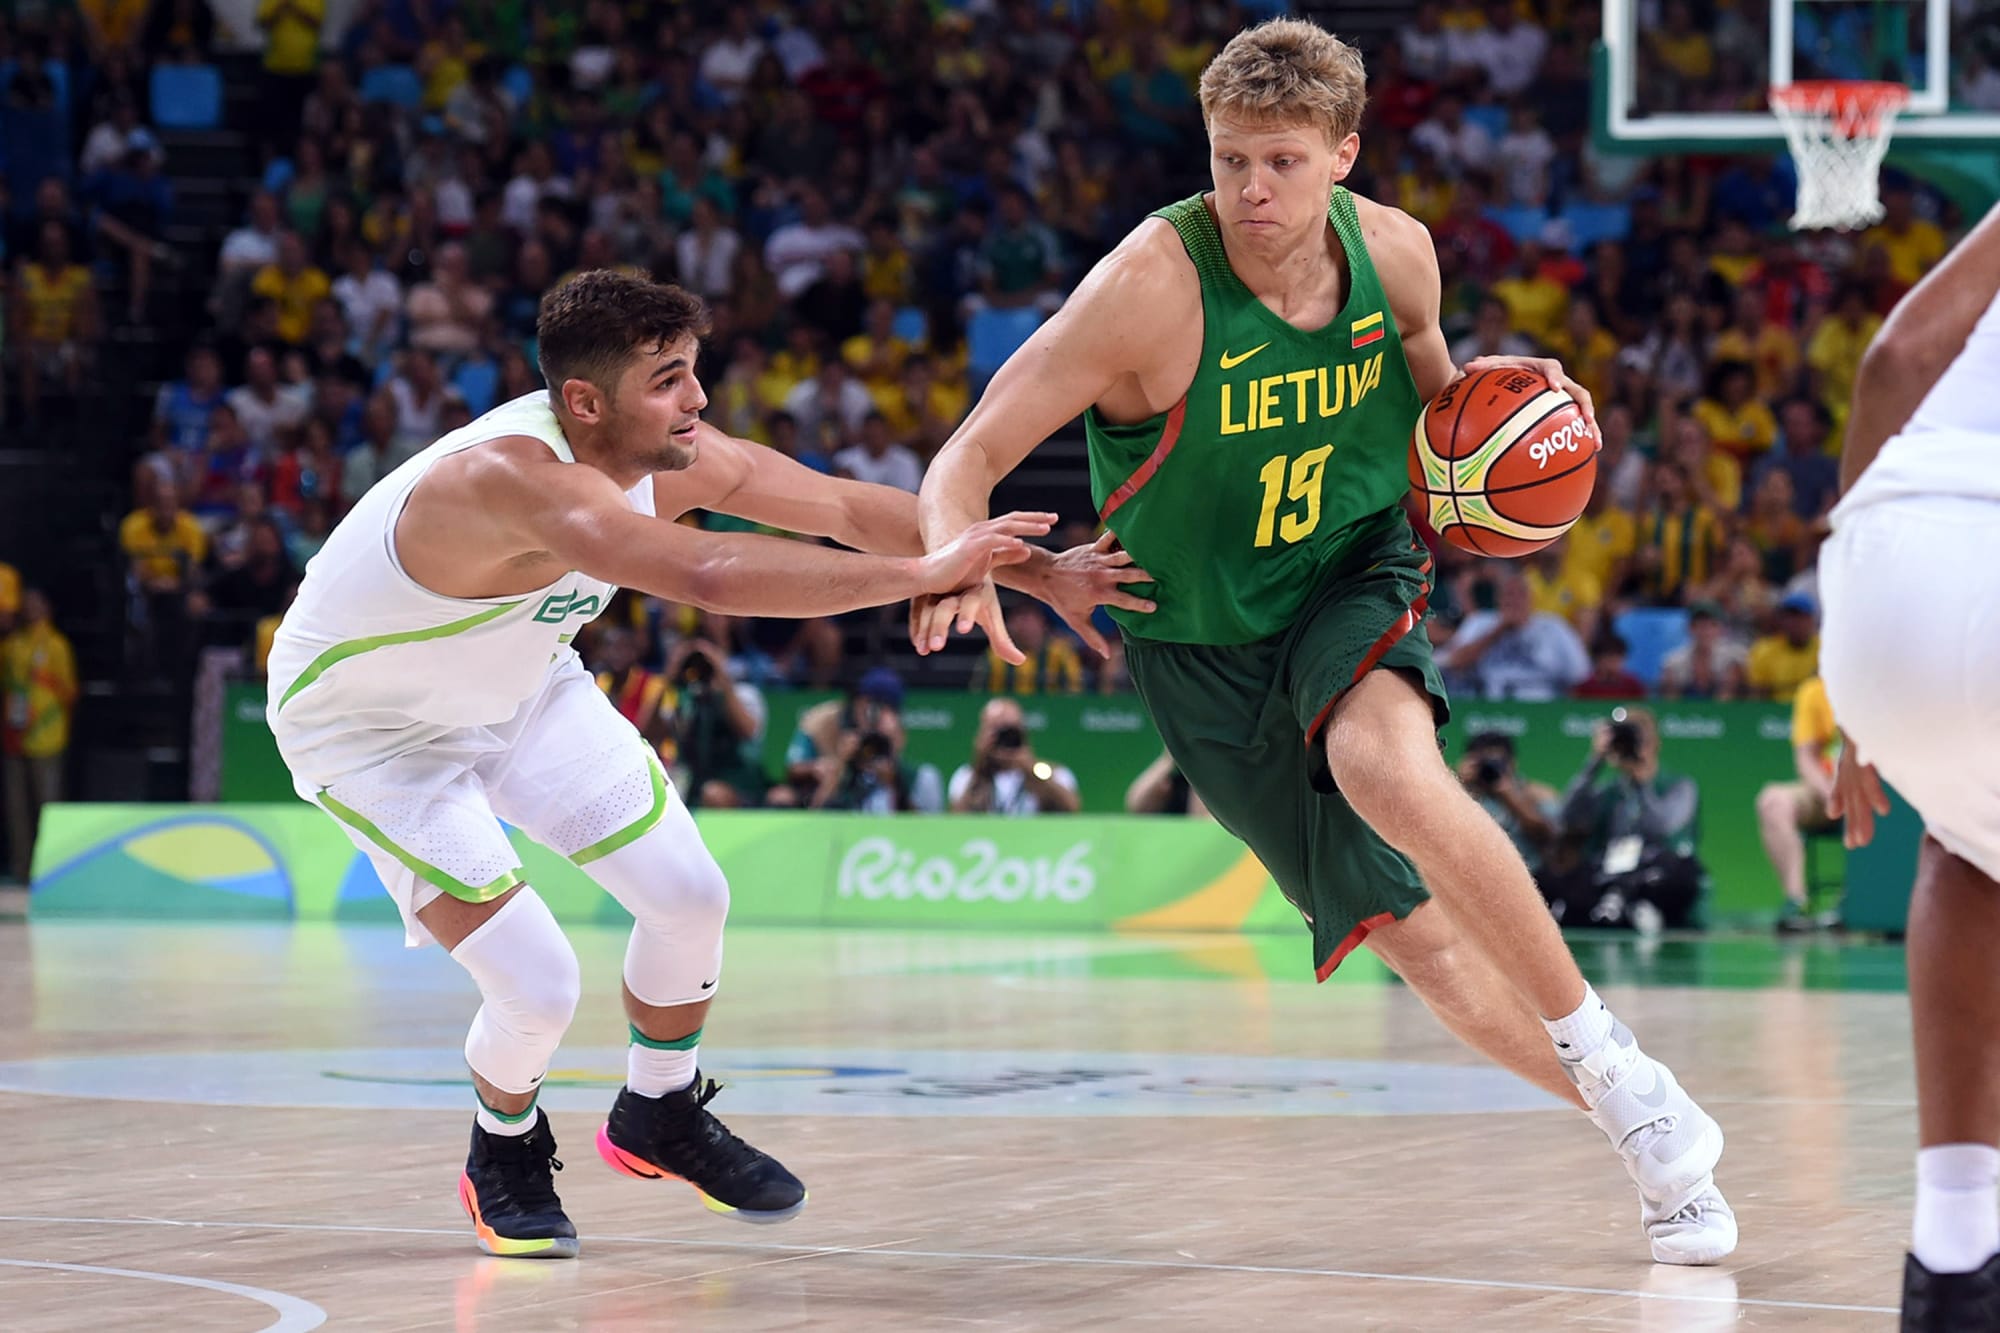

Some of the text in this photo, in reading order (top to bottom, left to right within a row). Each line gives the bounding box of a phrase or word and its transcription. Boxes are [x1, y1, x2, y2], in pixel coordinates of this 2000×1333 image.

[1220, 351, 1384, 435] LIETUVA
[1254, 443, 1335, 548] 19
[838, 836, 1096, 903] Rio2016
